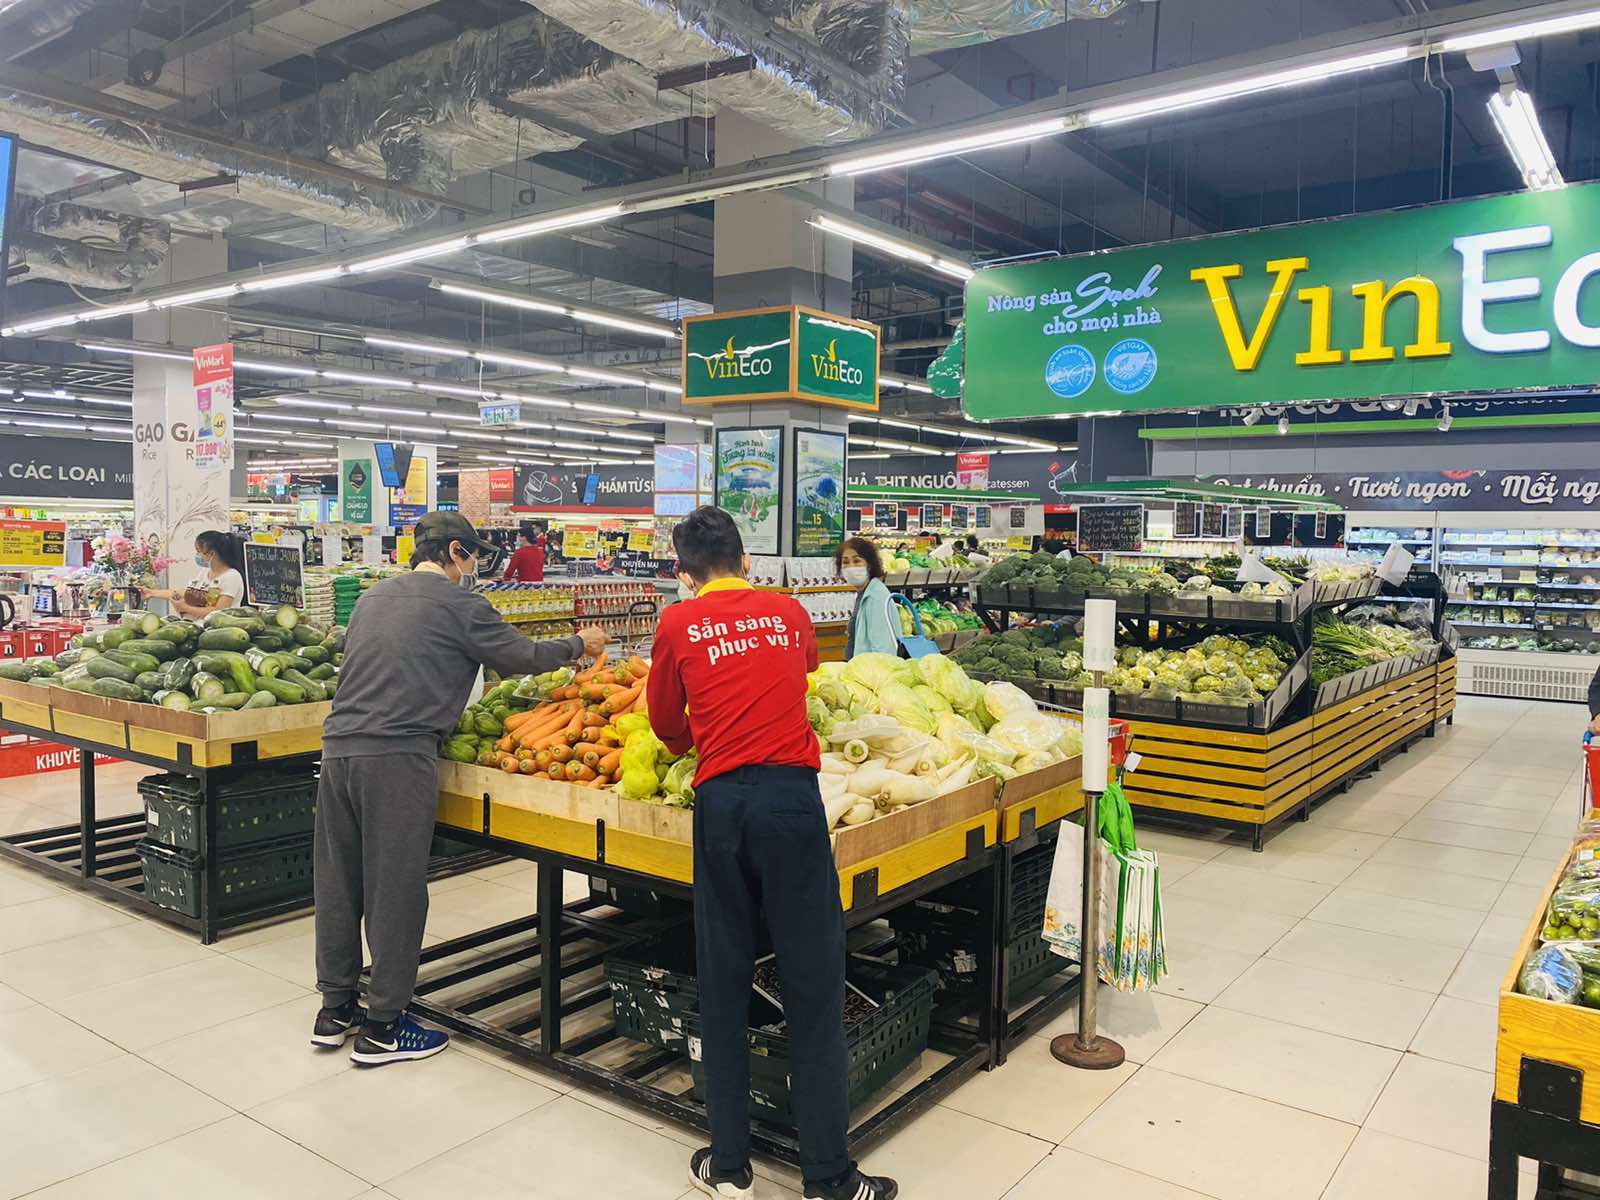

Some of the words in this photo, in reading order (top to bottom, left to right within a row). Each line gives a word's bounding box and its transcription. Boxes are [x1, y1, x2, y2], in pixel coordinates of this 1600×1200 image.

[988, 294, 1036, 312] Nông
[1040, 288, 1073, 306] sản
[1062, 264, 1162, 318] Sạch
[1190, 225, 1600, 371] VinEc
[1043, 316, 1078, 335] cho
[1081, 312, 1119, 332] mọi
[1123, 306, 1161, 327] nhà
[196, 355, 224, 370] VinMart
[705, 353, 772, 380] VinEco
[811, 353, 863, 385] VinEco
[9, 460, 52, 480] CÁC
[58, 466, 105, 486] LOẠI
[848, 471, 868, 485] HẢ
[987, 479, 1030, 489] catessen
[1349, 475, 1402, 498] Tươi
[1406, 479, 1472, 504] ngon
[1501, 472, 1560, 504] Mỗi
[1563, 479, 1600, 504] ng
[687, 617, 729, 643] Sẵn
[735, 614, 787, 633] sàng
[707, 637, 760, 666] phục
[765, 634, 790, 651] vụ
